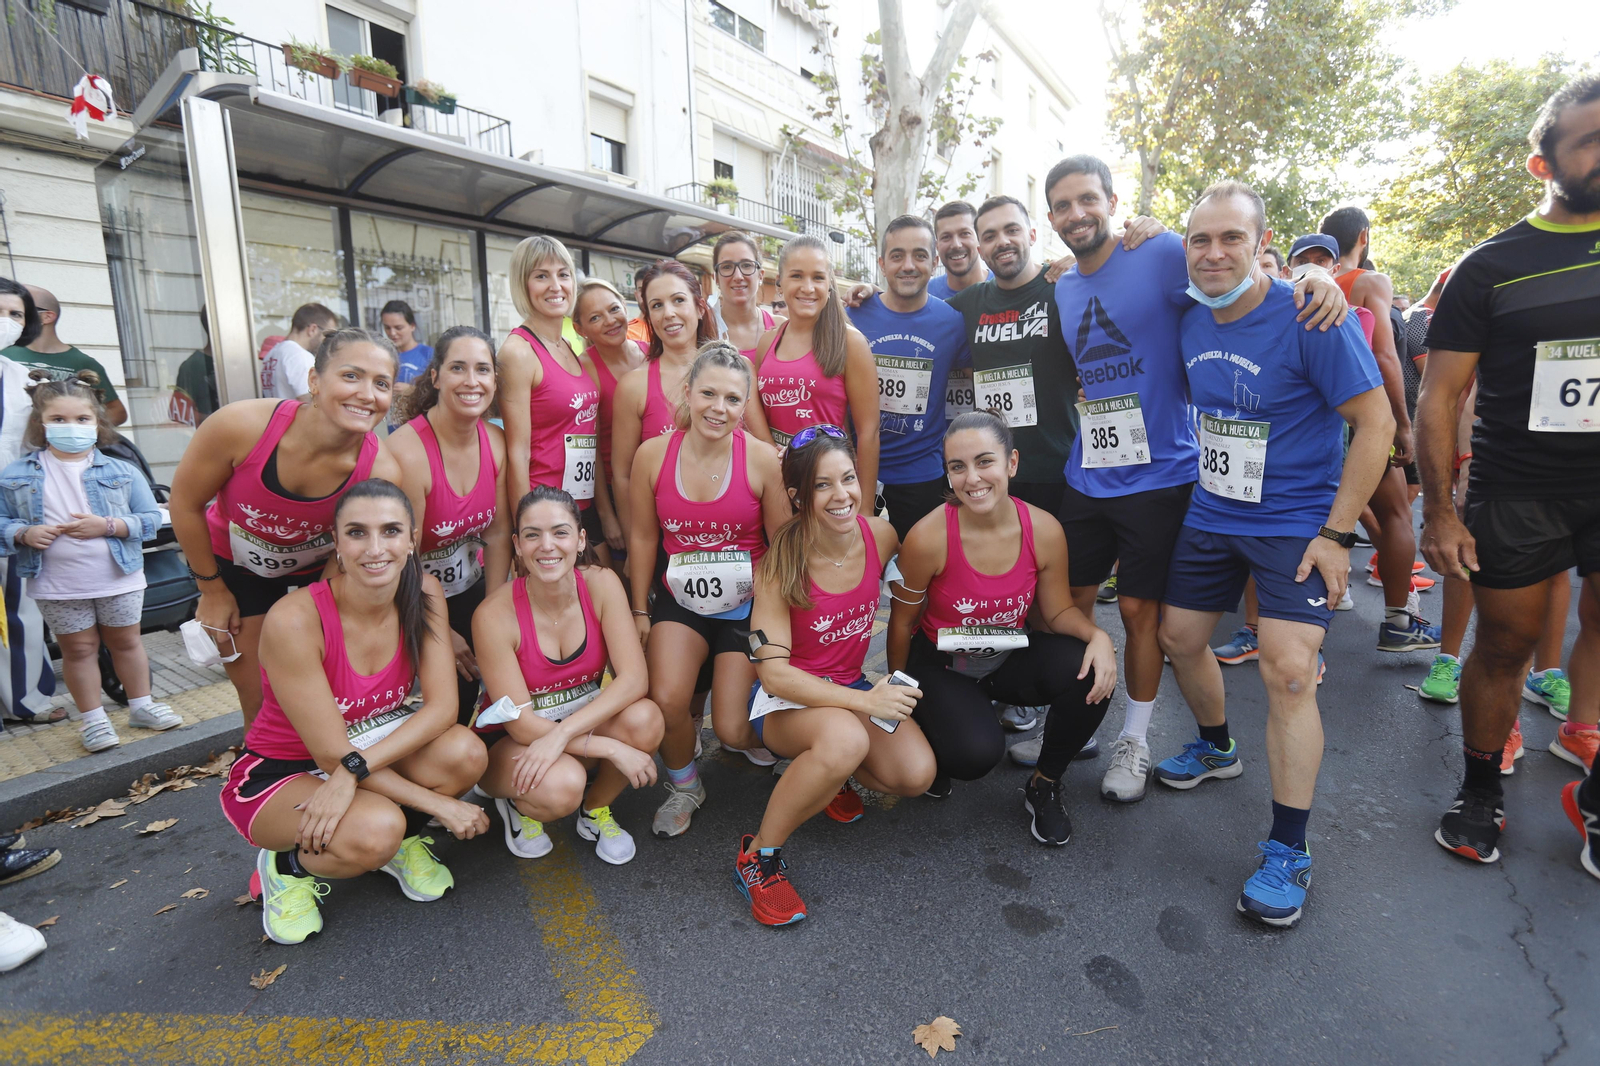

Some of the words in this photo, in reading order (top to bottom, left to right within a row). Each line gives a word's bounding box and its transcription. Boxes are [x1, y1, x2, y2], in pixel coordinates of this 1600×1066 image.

[974, 318, 1048, 343] HUELVA
[877, 334, 903, 344] VUELTA
[910, 335, 936, 352] HUELVA
[1548, 346, 1562, 358] 34
[1567, 344, 1600, 358] VUEL
[878, 359, 899, 368] VUELTA
[1077, 356, 1145, 386] Reebok
[1198, 350, 1223, 362] VUELTA
[1229, 353, 1261, 376] HUELVA
[768, 377, 816, 387] HYROX
[984, 371, 1001, 382] VUELTA
[1007, 368, 1029, 378] HUELVA
[762, 385, 811, 408] Queen
[946, 389, 973, 405] 469
[985, 392, 1013, 411] 388
[1110, 398, 1134, 410] HUELVA
[1090, 426, 1119, 449] 385
[1229, 424, 1260, 437] HUELVA
[1203, 446, 1230, 476] 383
[685, 520, 742, 531] HYROX
[248, 536, 280, 553] VUELTA
[292, 539, 326, 552] HUELVA
[675, 530, 738, 548] Queen
[248, 551, 298, 570] 399
[684, 554, 709, 564] VUELTA
[718, 551, 745, 561] HUELVA
[684, 577, 723, 599] 403
[980, 591, 1031, 609] HYROX
[955, 626, 981, 635] VUELTA
[537, 693, 565, 708] VUELTA
[571, 682, 593, 699] HUELVA
[377, 708, 409, 726] HUELVA
